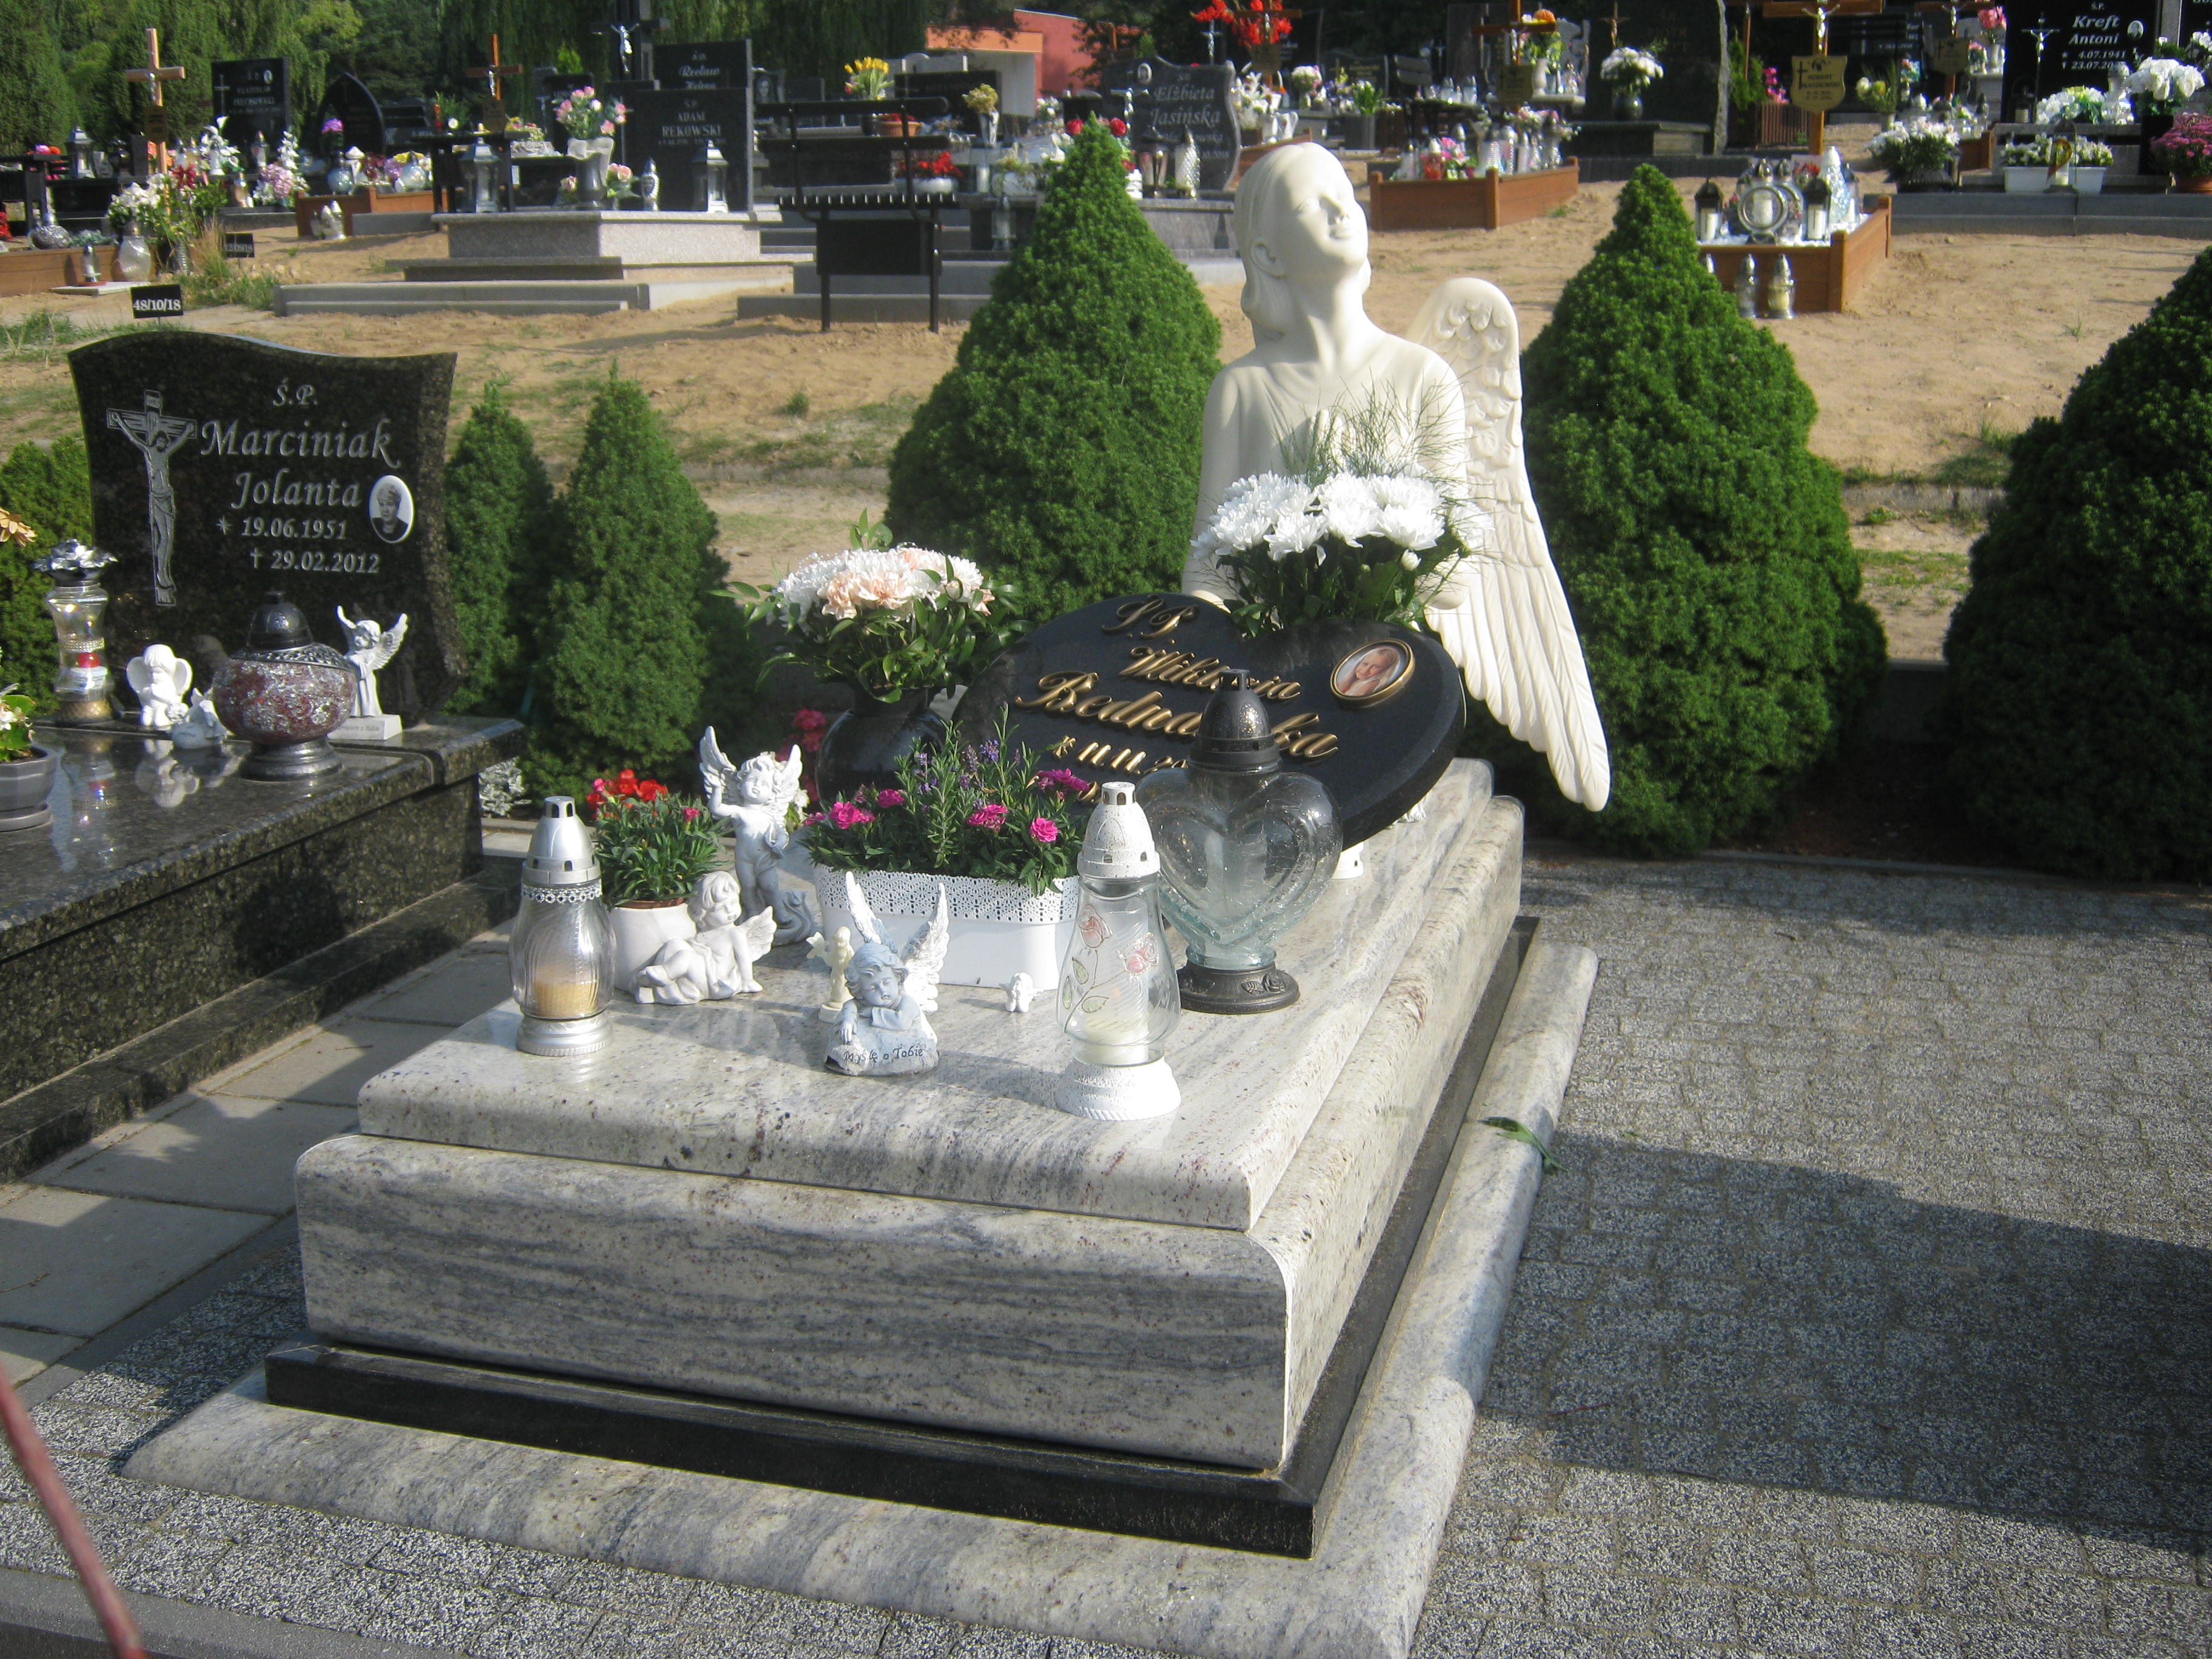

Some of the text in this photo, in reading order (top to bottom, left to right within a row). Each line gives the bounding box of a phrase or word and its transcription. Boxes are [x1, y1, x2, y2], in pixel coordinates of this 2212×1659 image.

[2072, 15, 2120, 30] Kreft
[2068, 33, 2120, 44] Antoni
[2078, 50, 2126, 59] 4.07.1941
[1153, 84, 1215, 101] Elżbieta
[677, 111, 705, 122] ADAM
[1150, 104, 1221, 128] Jasińska
[662, 124, 722, 137] REKOWSKI
[133, 298, 181, 312] 48/10/18
[273, 377, 318, 406] Ś.P.
[201, 417, 401, 469] Marciniak
[230, 468, 363, 509] Jolanta
[241, 516, 347, 540] 19.06.1951
[270, 549, 381, 573] 29.02.2012
[893, 1045, 923, 1059] Tobie
